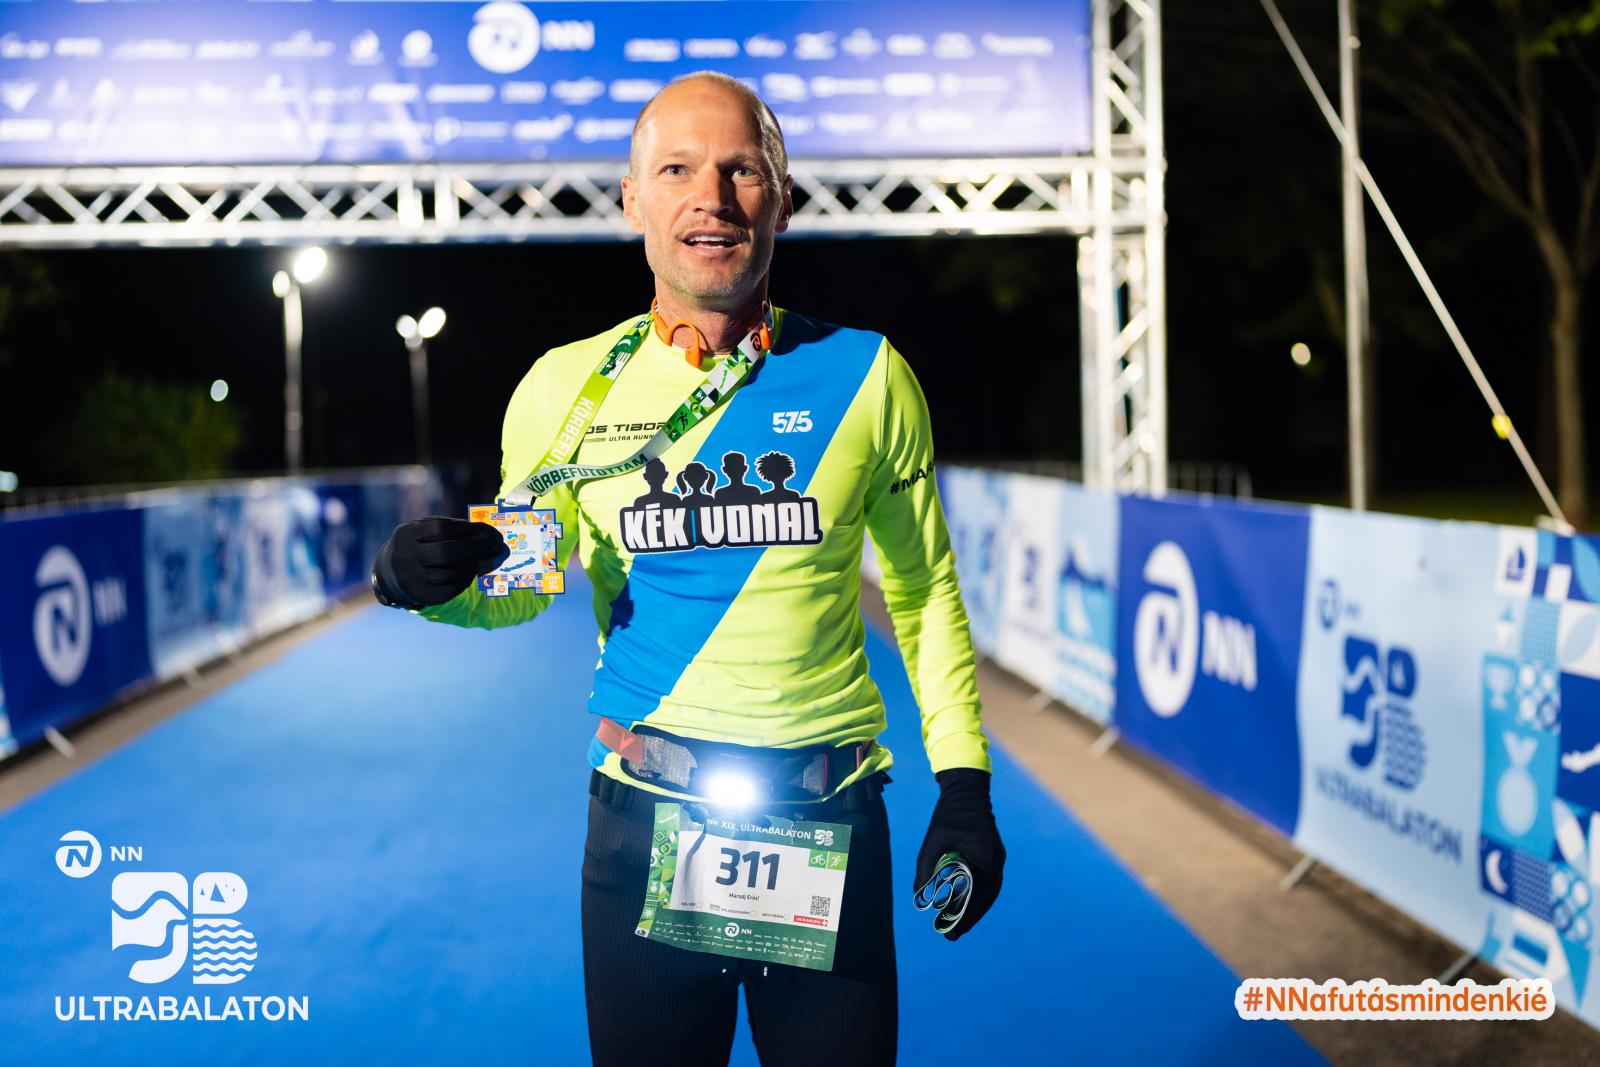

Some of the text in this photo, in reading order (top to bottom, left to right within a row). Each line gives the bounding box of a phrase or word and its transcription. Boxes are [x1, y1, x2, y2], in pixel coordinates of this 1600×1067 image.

[541, 20, 595, 51] NN
[527, 453, 649, 494] KÖRBEFUTOTTAM
[624, 502, 819, 549] KÉK VONAL
[1202, 611, 1258, 691] NN
[741, 824, 811, 841] ULTRABALATON
[715, 847, 781, 890] 311
